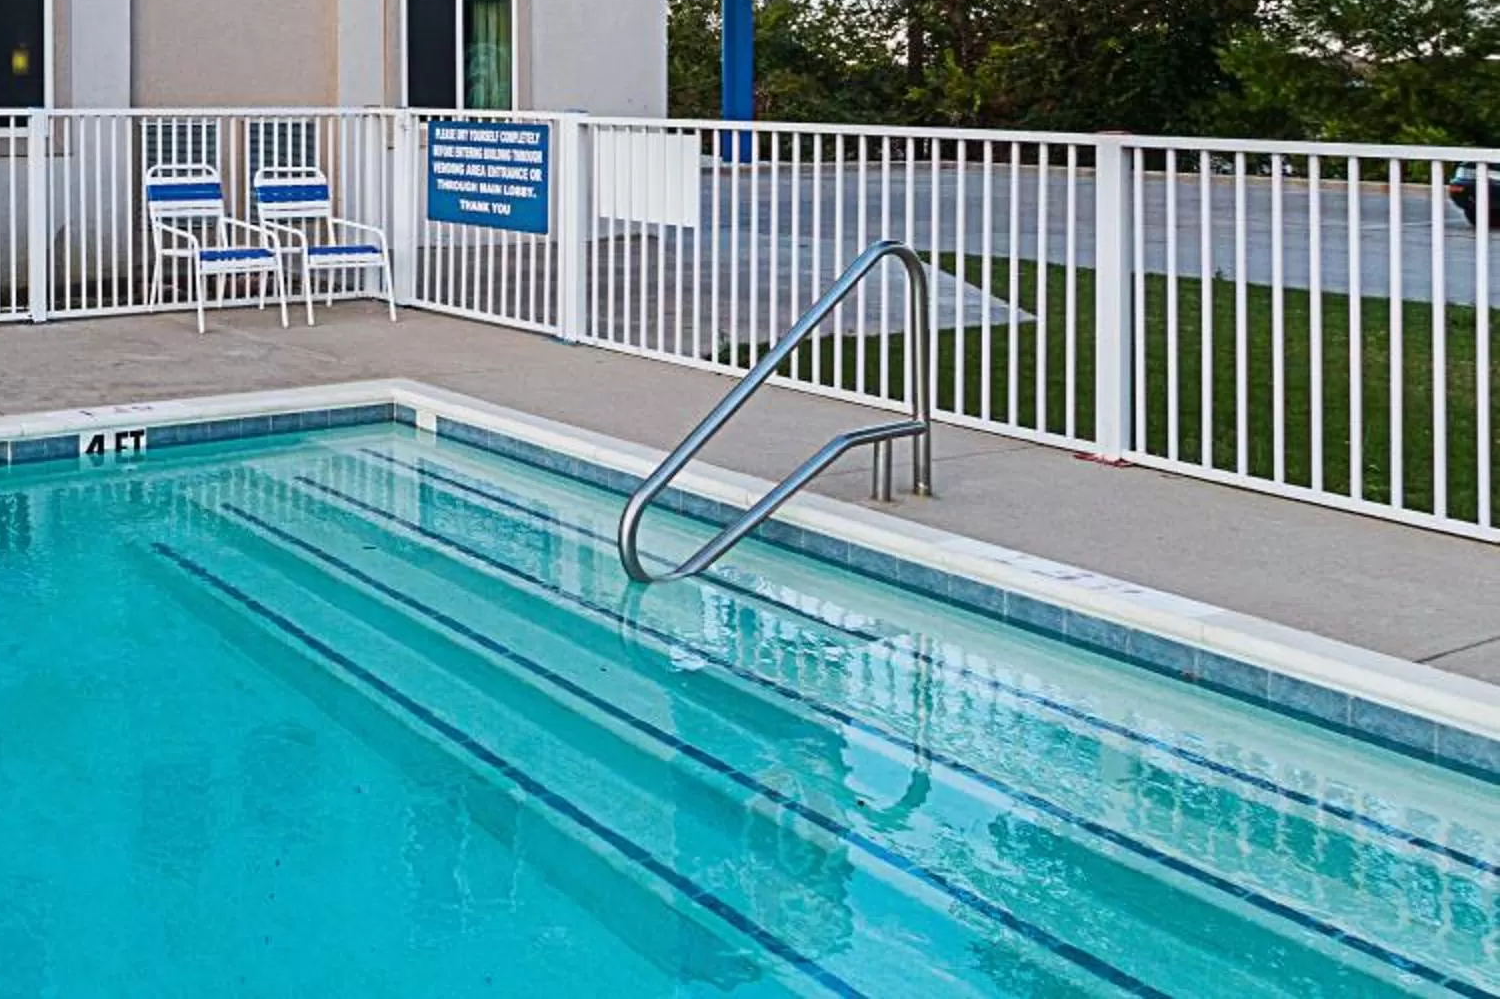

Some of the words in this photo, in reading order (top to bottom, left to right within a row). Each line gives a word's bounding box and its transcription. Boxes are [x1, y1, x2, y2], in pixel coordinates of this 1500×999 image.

[435, 127, 457, 141] PLEASE
[469, 129, 499, 143] YOURSELF
[500, 130, 540, 145] COMPLETELY
[432, 161, 465, 176] VENDING
[466, 163, 487, 178] AREA
[487, 164, 529, 180] ENTRANCE
[529, 168, 543, 182] OR
[436, 178, 478, 193] THROUGH
[479, 182, 503, 196] MAIN
[503, 184, 537, 199] LOBBY.
[459, 199, 490, 213] THANK
[491, 202, 511, 216] YOU
[85, 434, 105, 454] 4
[115, 429, 145, 453] FT
